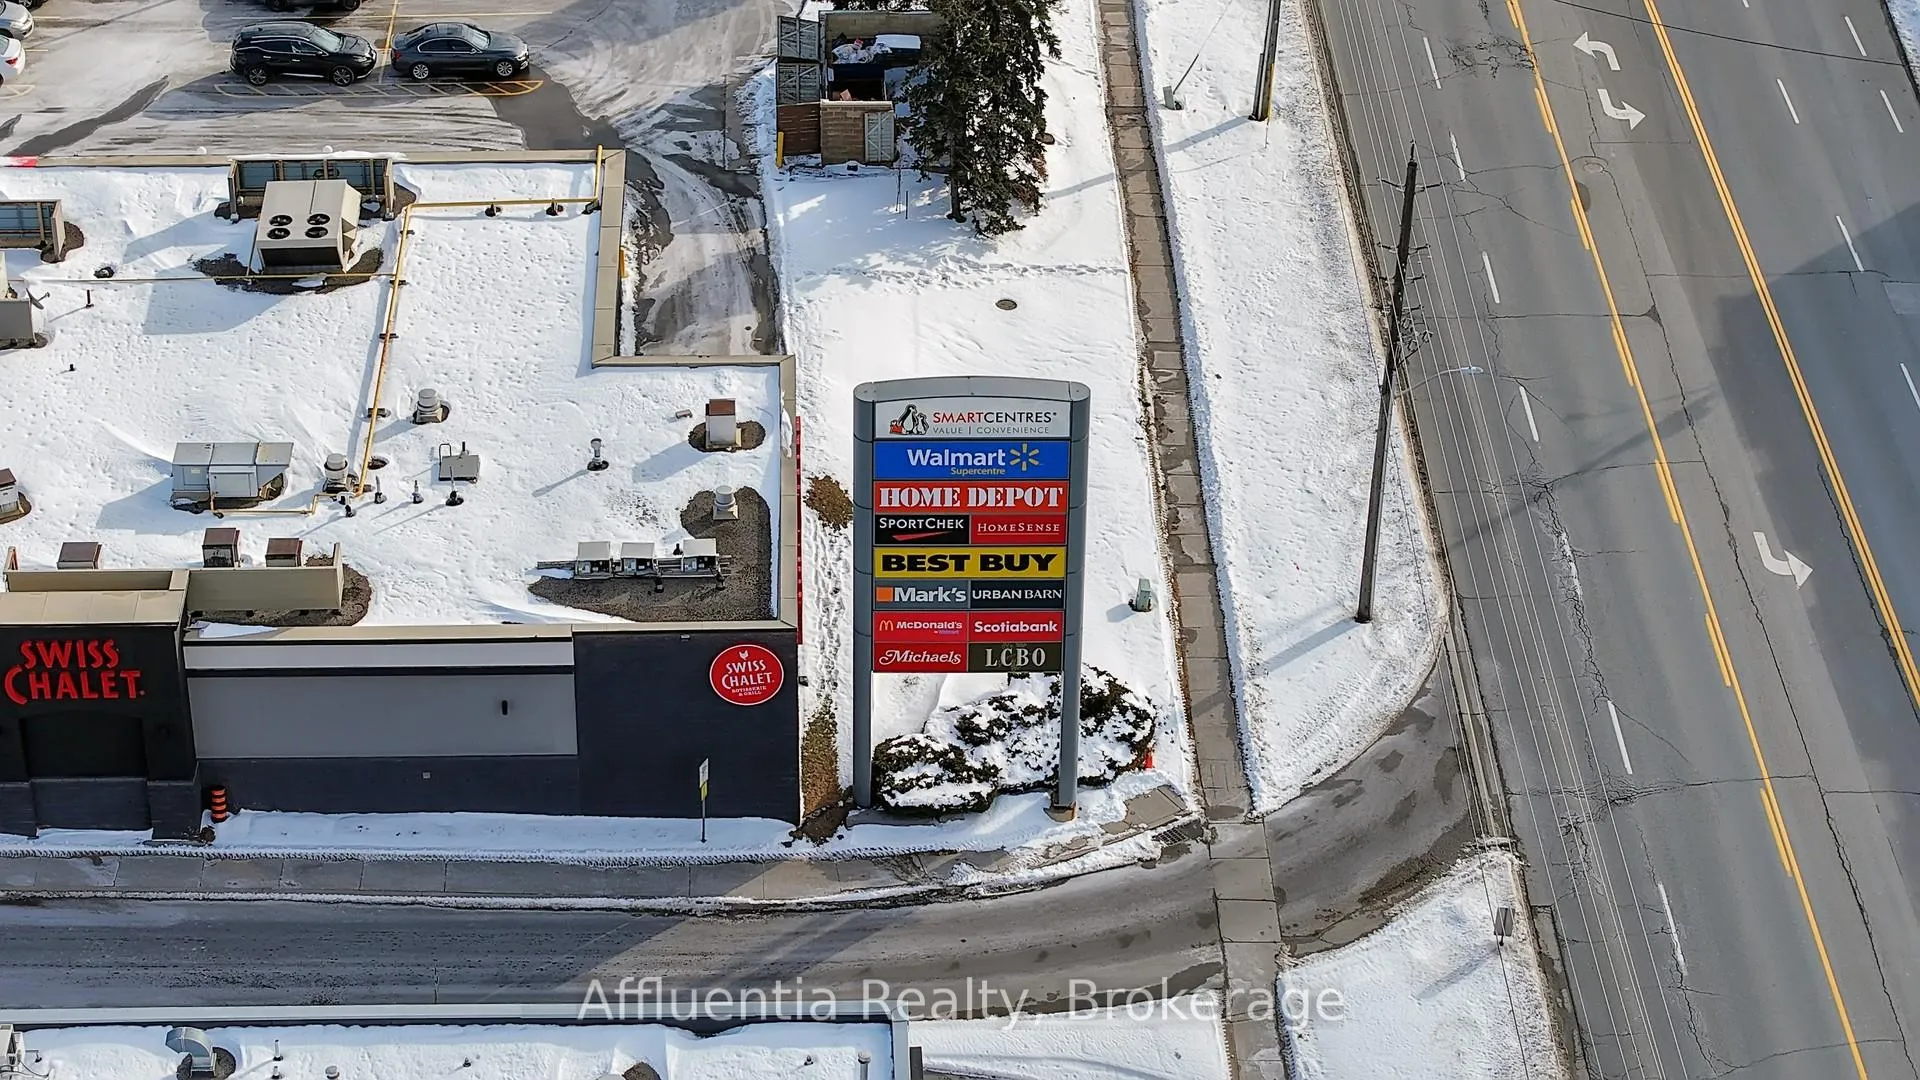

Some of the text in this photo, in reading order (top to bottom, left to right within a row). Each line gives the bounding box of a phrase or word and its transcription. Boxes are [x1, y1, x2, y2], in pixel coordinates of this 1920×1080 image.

[933, 426, 1049, 434] VALUE CONVENIENCE
[907, 449, 1006, 466] Walmart
[951, 467, 1006, 475] Supercentre
[879, 487, 1063, 507] HOME DEPOT
[879, 518, 964, 530] SPORTCHEK
[882, 554, 1058, 572] BEST BUY
[895, 586, 967, 603] Mark's
[972, 589, 1062, 600] URBAN BARN
[896, 621, 963, 630] McDonald's
[974, 621, 1057, 633] Scotiabank
[20, 639, 119, 669] SWISS
[878, 650, 962, 665] Michaels
[985, 648, 1046, 667] LCBO
[726, 660, 766, 674] SWISS
